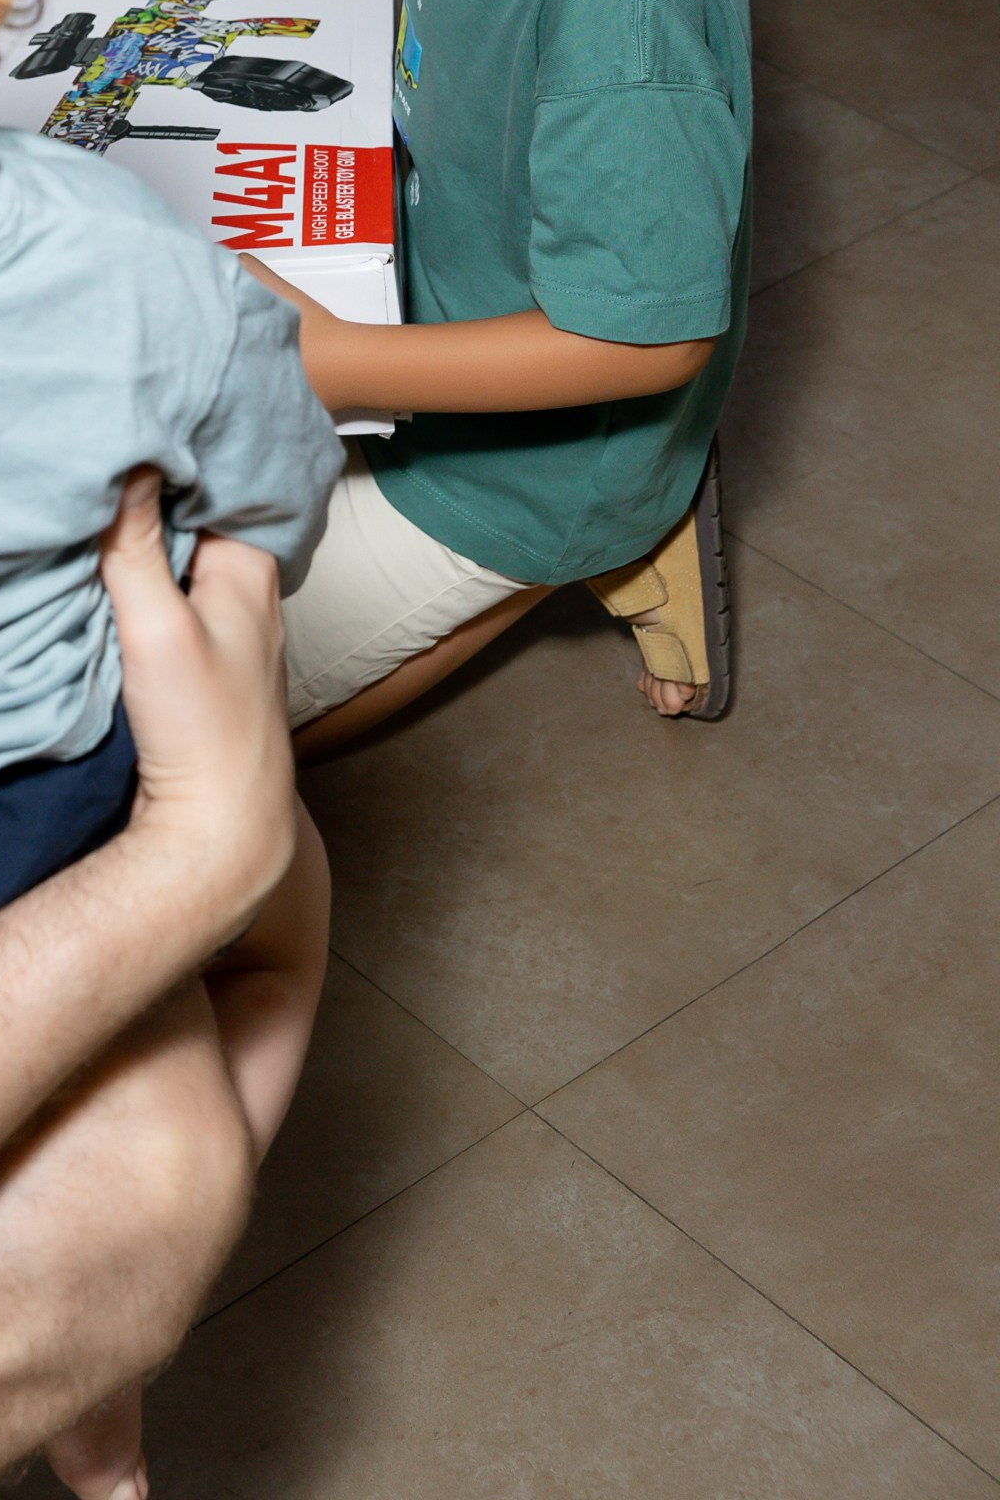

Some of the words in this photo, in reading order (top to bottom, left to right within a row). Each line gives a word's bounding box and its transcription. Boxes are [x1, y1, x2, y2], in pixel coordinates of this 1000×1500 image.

[313, 149, 329, 179] SHOOT
[337, 150, 355, 166] GUN
[336, 166, 355, 184] TOY
[211, 143, 297, 250] M4A1
[312, 182, 328, 212] SPEED
[336, 183, 355, 221] BLASTER
[312, 215, 327, 240] HIGH
[335, 221, 355, 239] GEL
